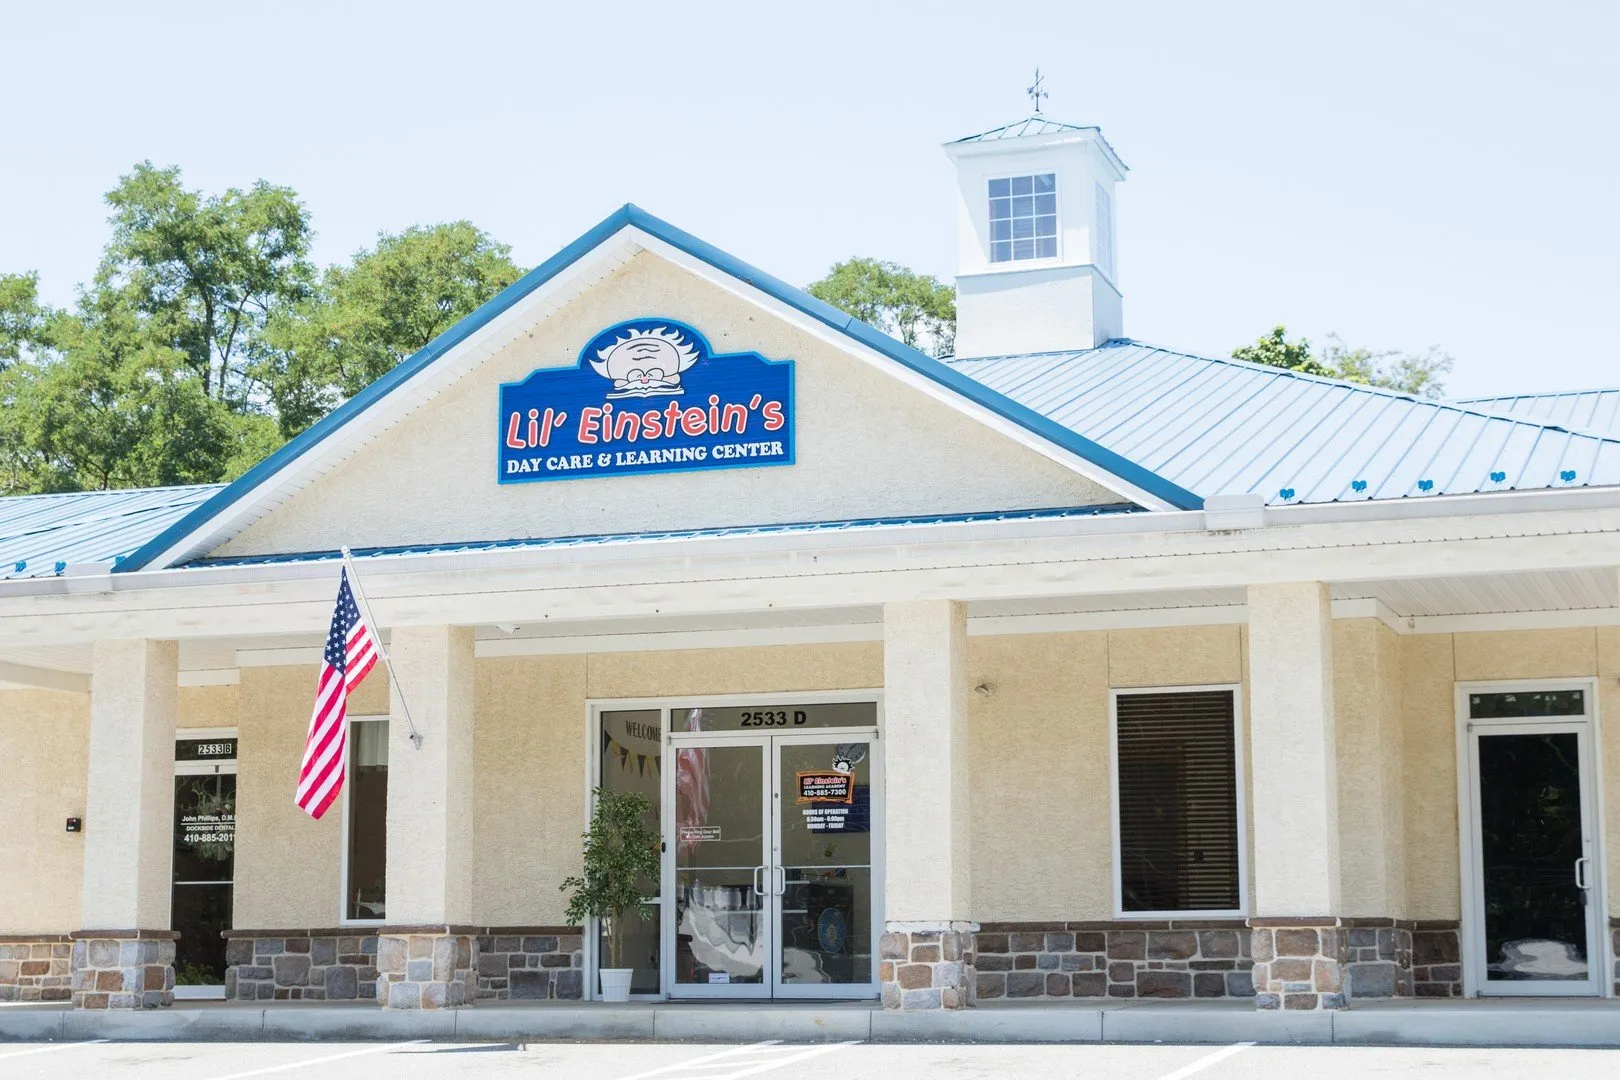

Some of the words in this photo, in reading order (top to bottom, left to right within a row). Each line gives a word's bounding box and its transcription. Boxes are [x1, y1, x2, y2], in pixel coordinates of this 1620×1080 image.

[506, 407, 567, 449] Lil'
[577, 394, 785, 444] Einstein's
[506, 457, 542, 473] DAY
[546, 454, 593, 470] CARE
[597, 453, 612, 467] &
[615, 446, 707, 466] LEARNING
[711, 441, 784, 459] CENTER
[741, 711, 787, 726] 2533
[794, 710, 807, 725] D
[198, 744, 224, 755] 2533
[225, 744, 232, 754] B
